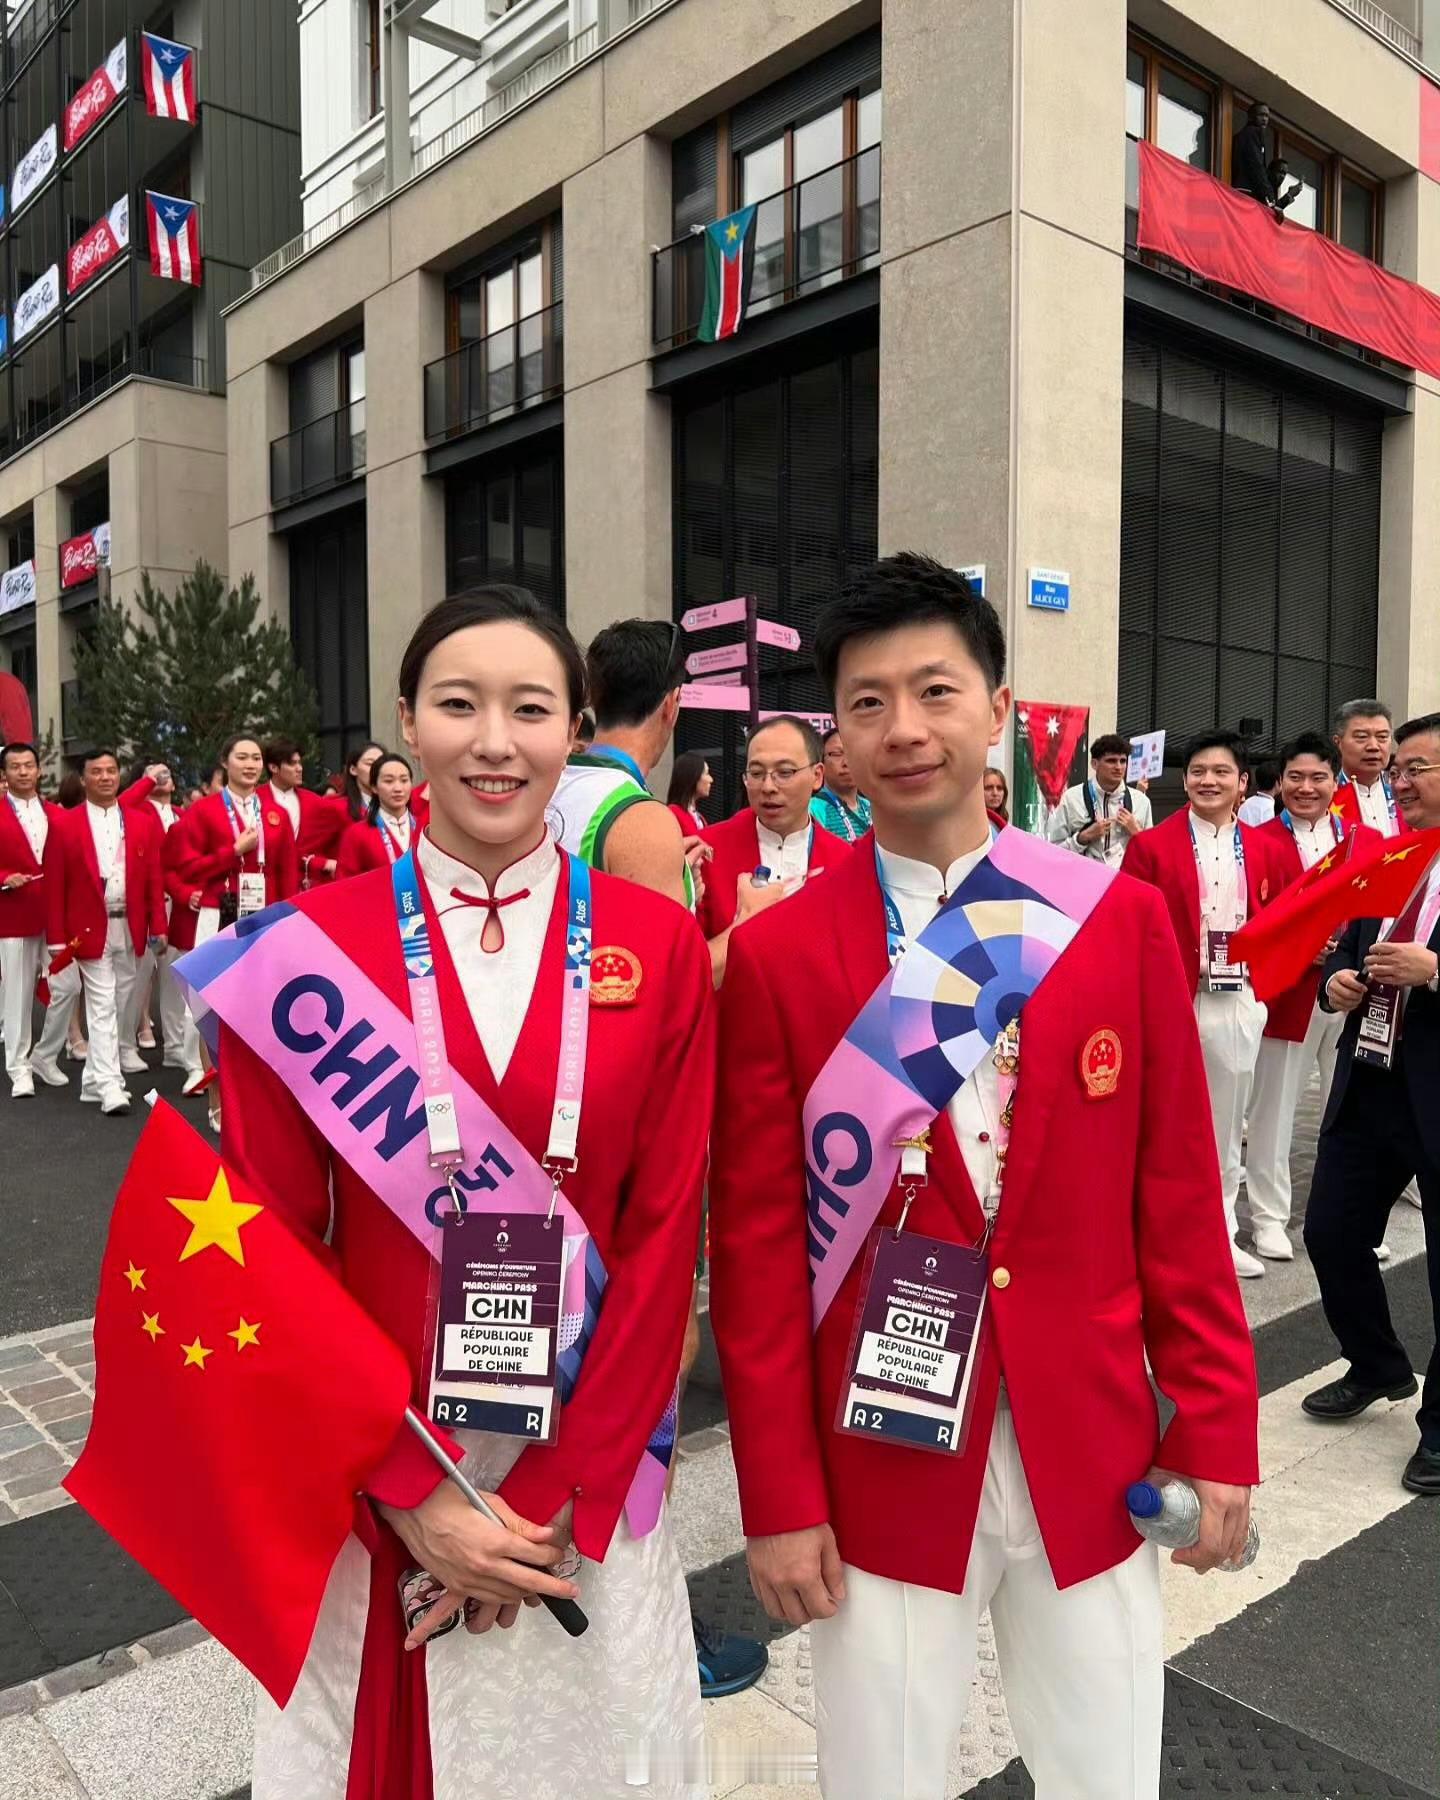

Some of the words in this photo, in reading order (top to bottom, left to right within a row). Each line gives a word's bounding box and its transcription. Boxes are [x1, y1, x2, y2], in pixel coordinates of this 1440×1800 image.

[417, 986, 435, 1036] PARIS
[271, 973, 428, 1162] CHN
[424, 1041, 442, 1089] 2024
[563, 1042, 579, 1093] PARIS
[462, 1281, 513, 1292] MARCHING
[514, 1284, 538, 1293] PASS
[472, 1297, 527, 1320] CHN
[887, 1295, 933, 1313] MARCHING
[934, 1307, 955, 1319] PASS
[460, 1326, 534, 1343] RÉPUBLIQUE
[891, 1313, 944, 1343] CHN
[463, 1344, 529, 1358] POPULAIRE
[877, 1338, 944, 1364] RÉPUBLIQUE
[468, 1360, 483, 1370] DE
[486, 1360, 523, 1373] CHINE
[877, 1353, 938, 1377] POPULAIRE
[879, 1368, 893, 1380] DE
[895, 1372, 930, 1389] CHINE
[437, 1402, 450, 1420] A
[455, 1404, 468, 1422] 2
[525, 1412, 540, 1431] R
[854, 1408, 867, 1426] A
[871, 1412, 883, 1430] 2
[936, 1425, 950, 1444] R
